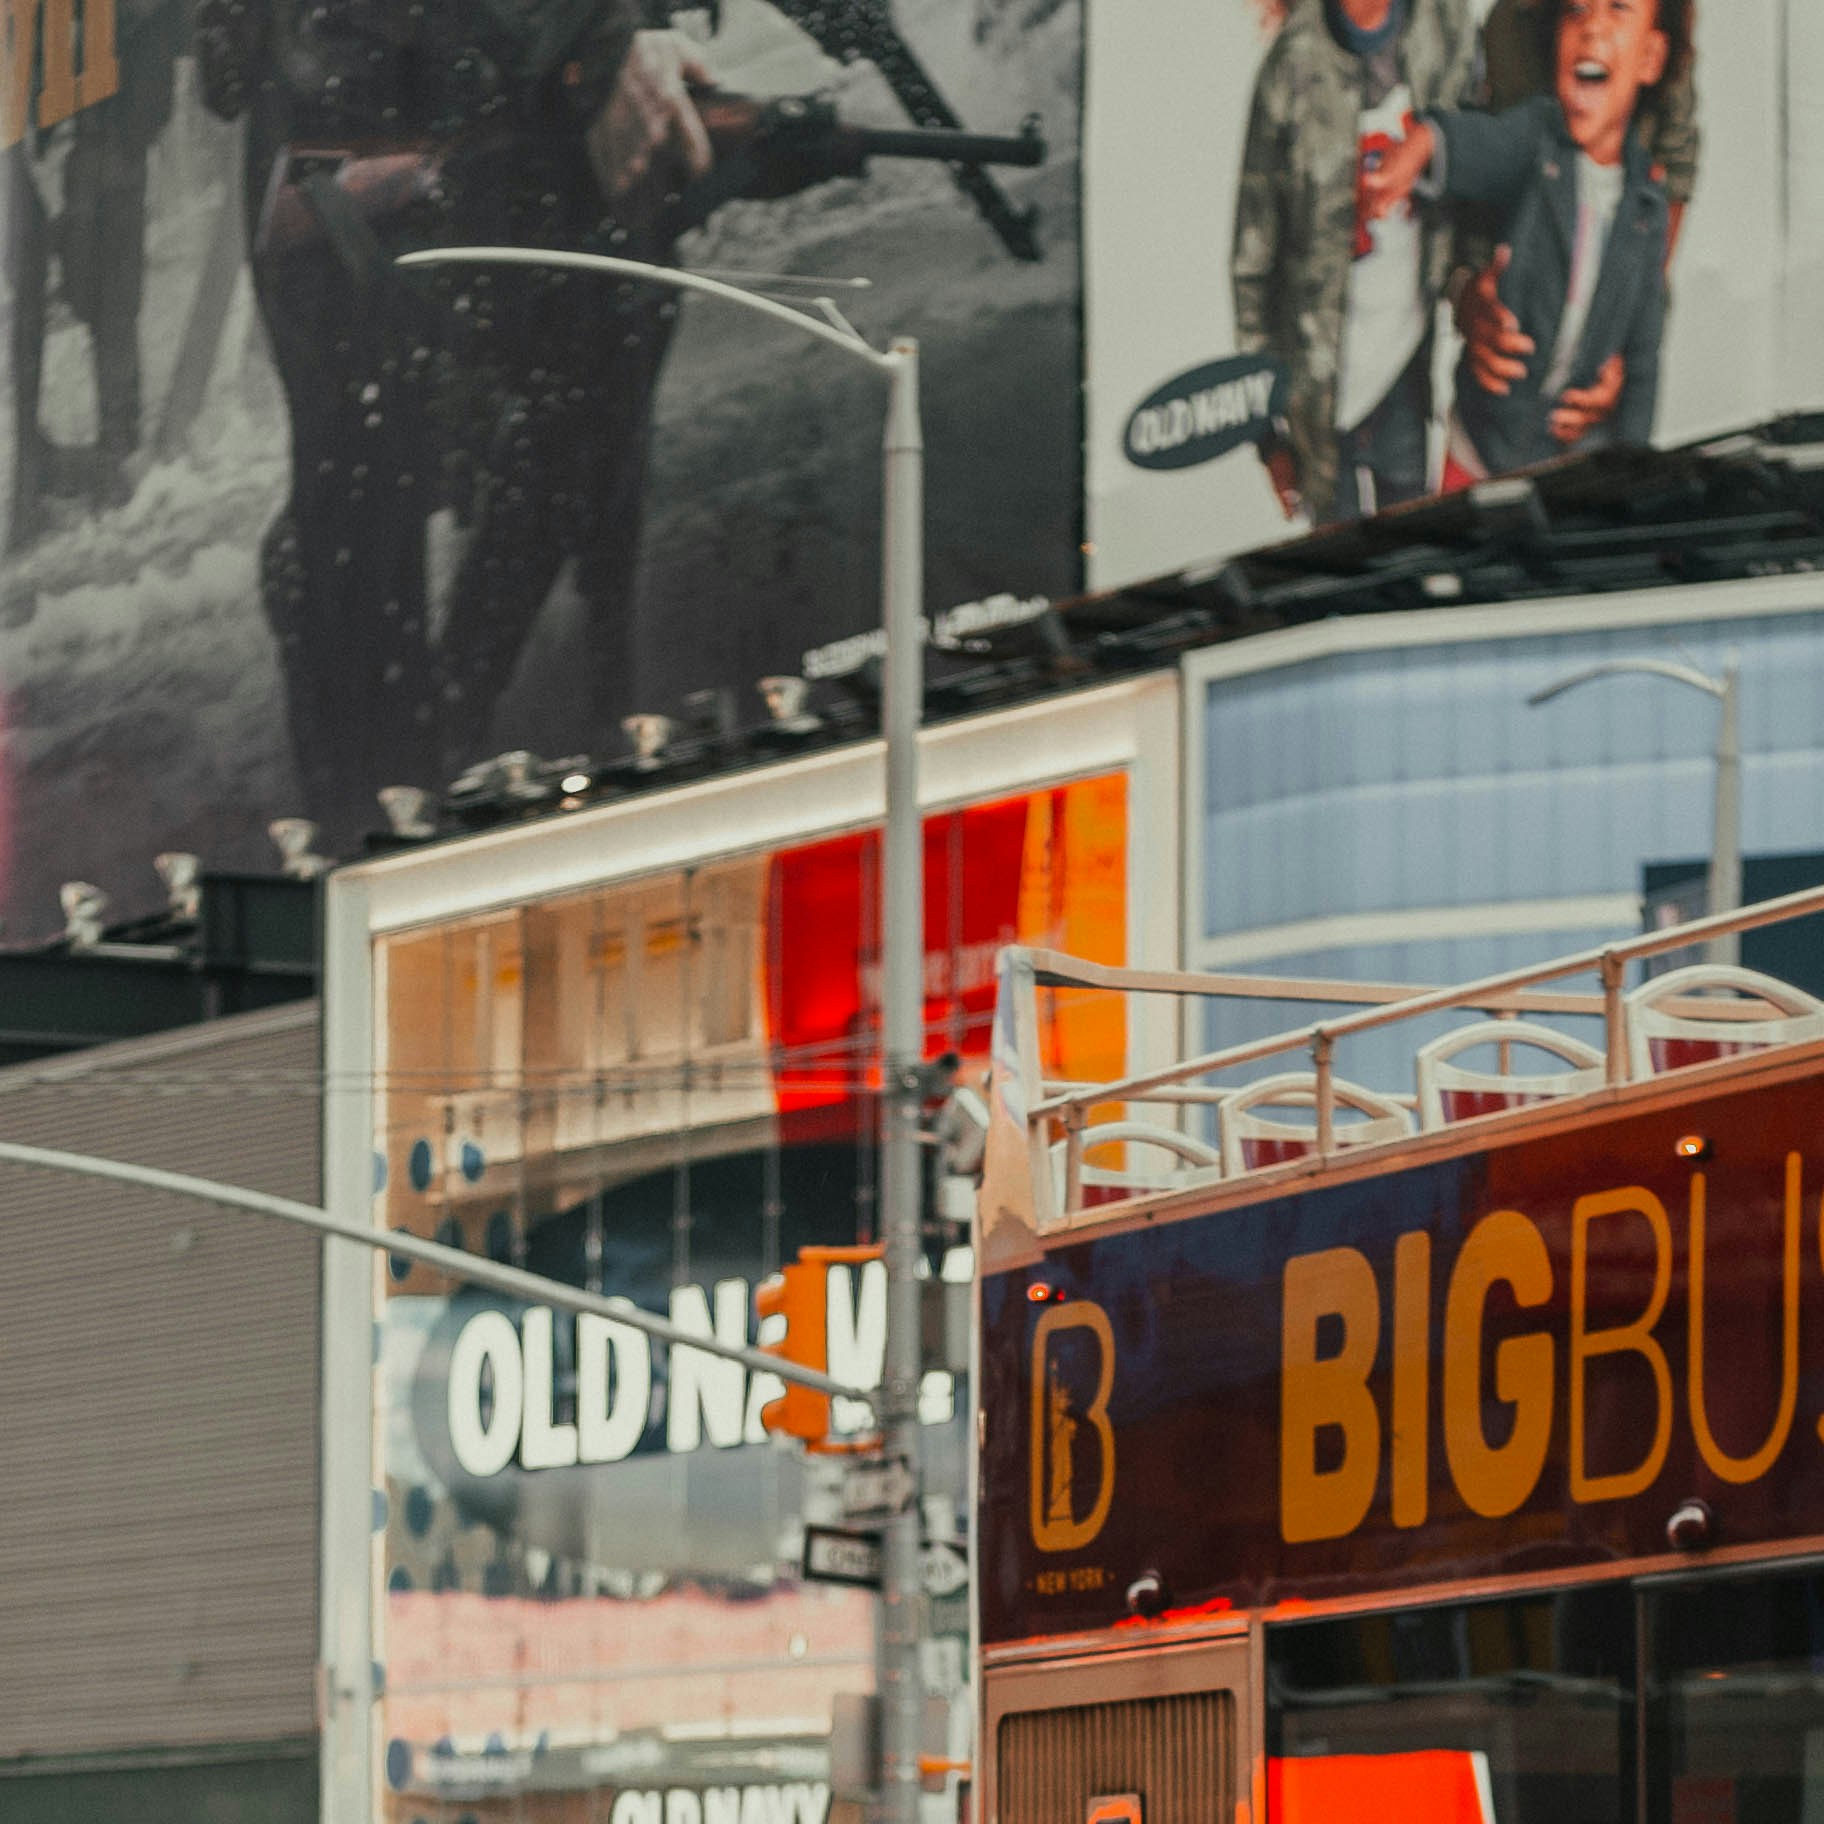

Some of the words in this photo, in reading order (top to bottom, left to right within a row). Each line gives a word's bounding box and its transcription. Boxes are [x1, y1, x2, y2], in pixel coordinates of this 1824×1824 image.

[1130, 398, 1194, 454] OLD
[1190, 369, 1276, 437] NAVY
[448, 1296, 651, 1477] OLD
[1036, 1571, 1066, 1594] NEW
[1070, 1567, 1105, 1591] YORK
